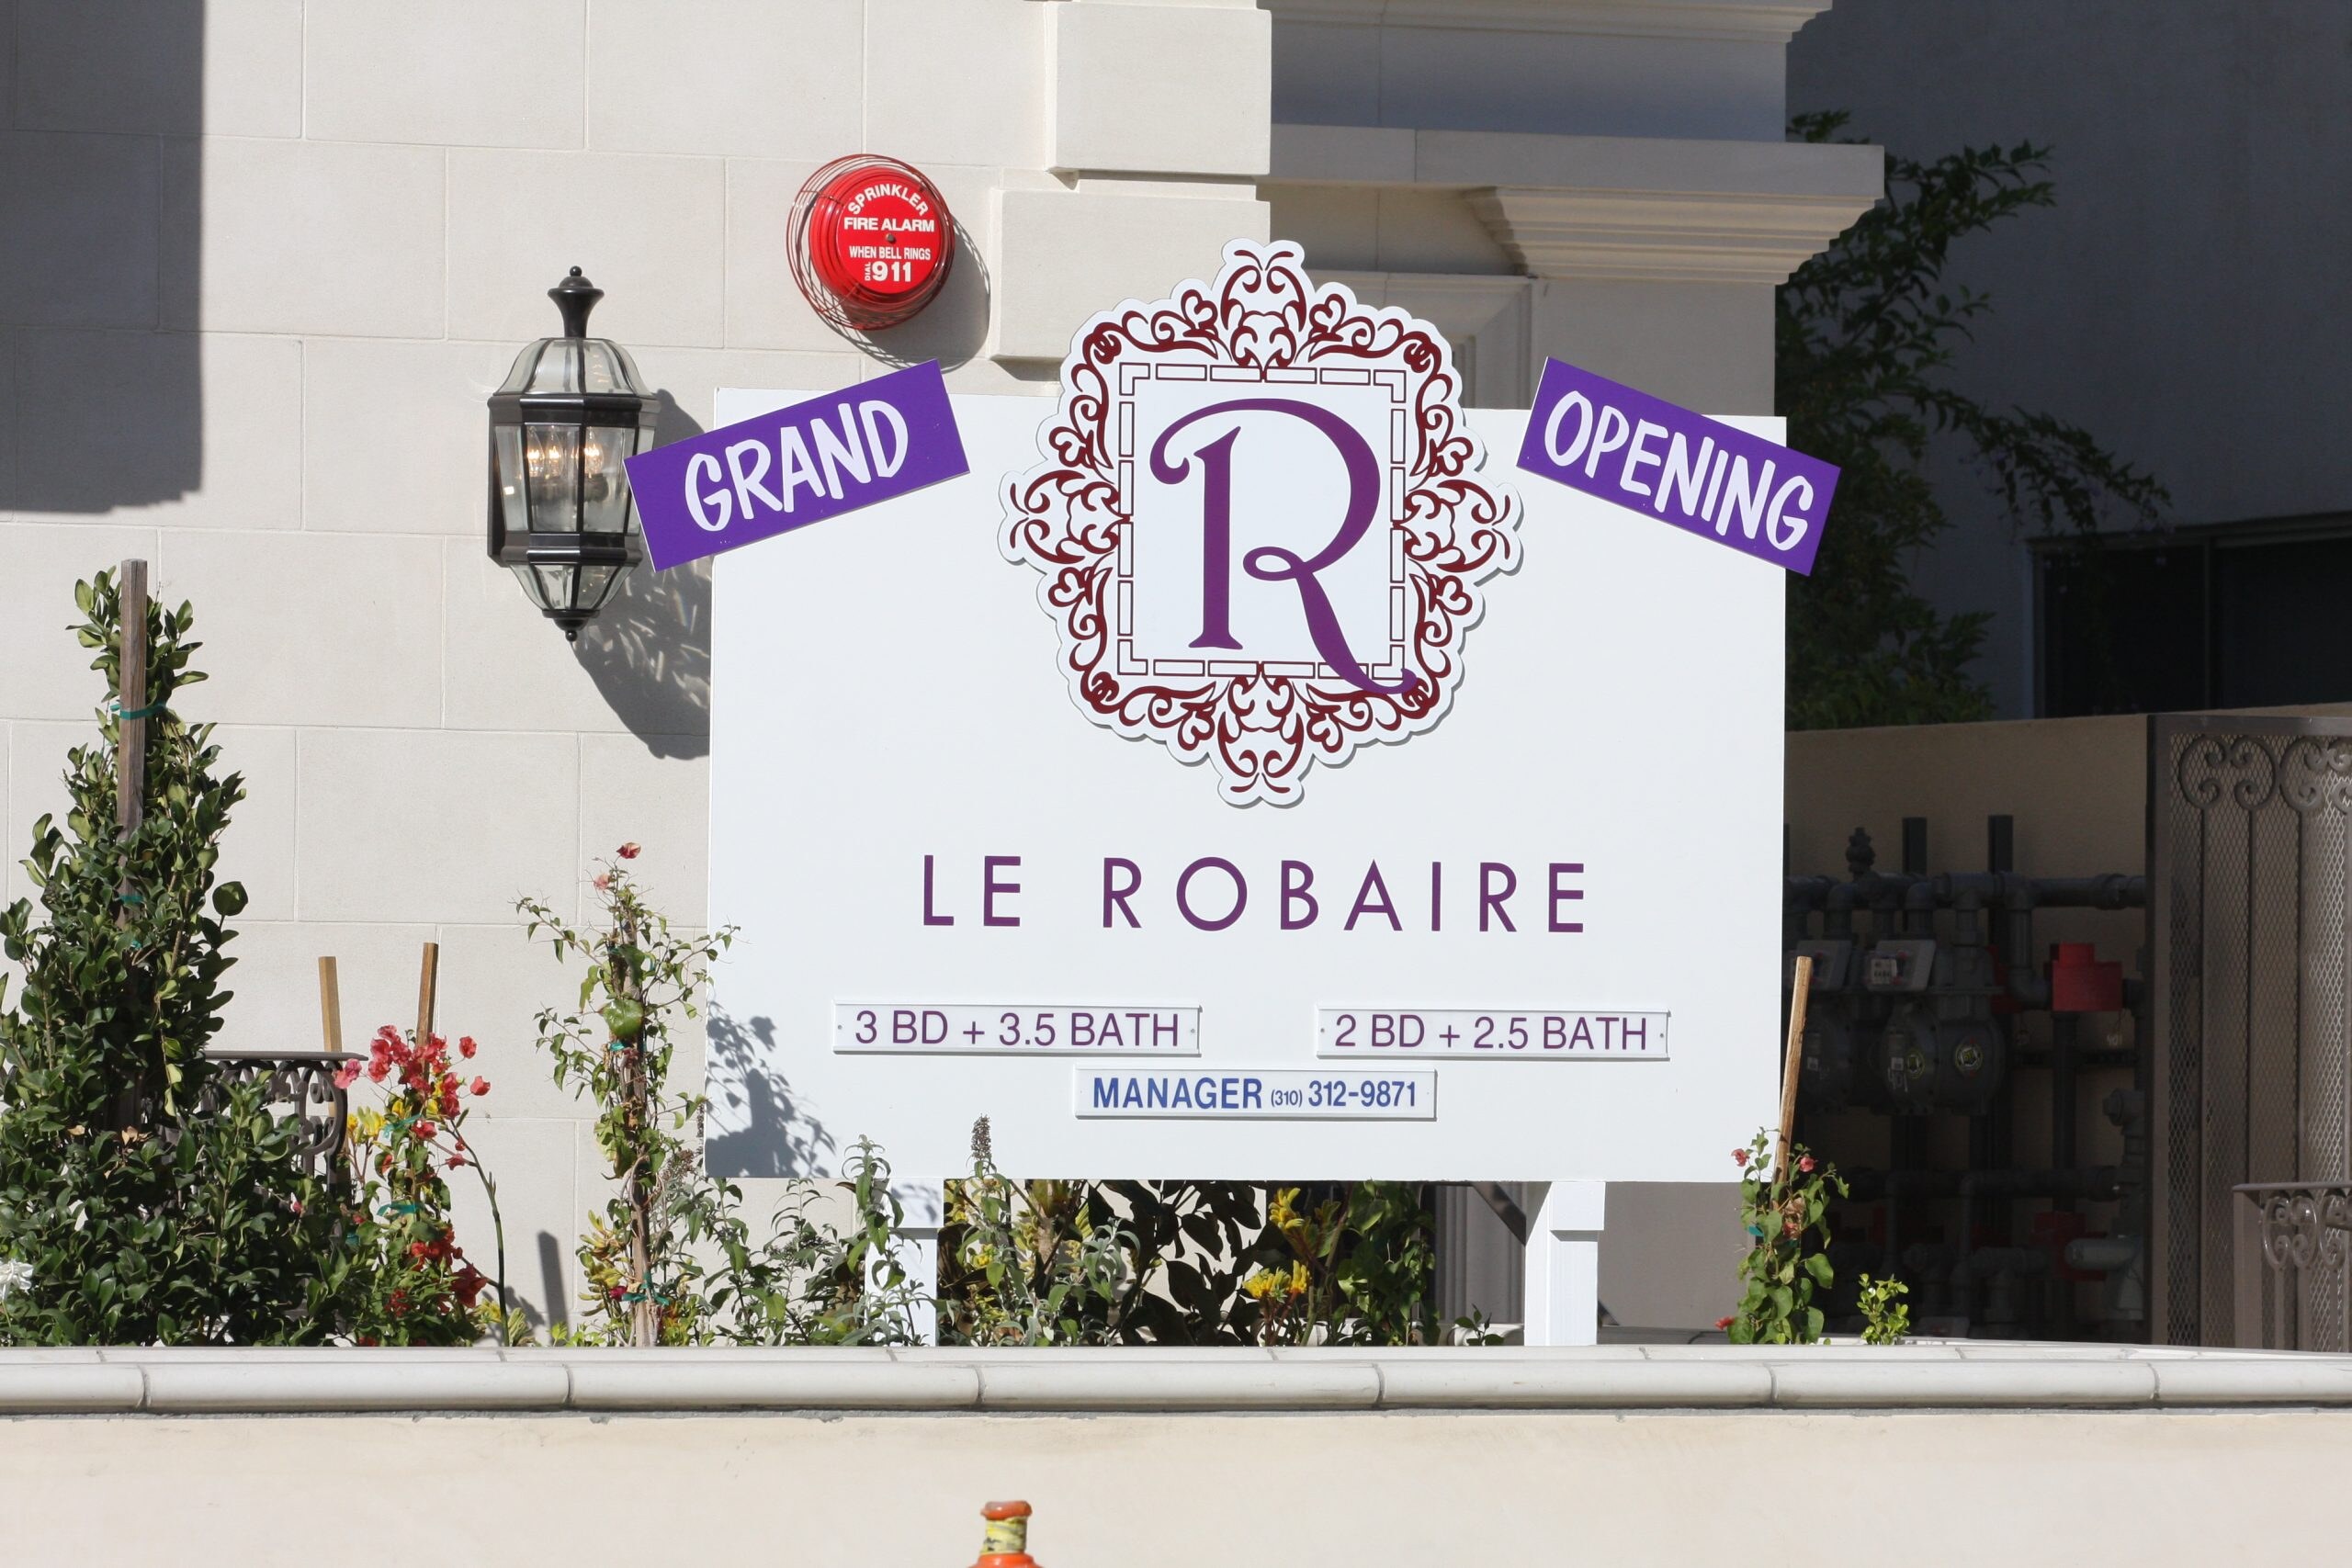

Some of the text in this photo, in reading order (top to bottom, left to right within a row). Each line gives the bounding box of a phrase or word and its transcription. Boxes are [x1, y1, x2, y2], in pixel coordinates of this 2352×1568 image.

[847, 184, 929, 216] SPRINKLER
[843, 217, 935, 232] FIRE ALARM
[849, 246, 931, 261] WHEN BELL RINGS
[872, 261, 911, 282] 911
[684, 400, 909, 532] GRAND
[1544, 390, 1815, 551] OPENING
[1149, 398, 1418, 694] R
[923, 855, 1584, 932] LE ROBAIRE
[855, 1010, 877, 1044] 3
[892, 1010, 948, 1044] BD
[999, 1012, 1056, 1047] 3.5
[1070, 1012, 1179, 1047] BATH
[1335, 1013, 1357, 1047] 2
[1371, 1014, 1425, 1048] BD
[1474, 1016, 1529, 1049] 2.5
[1543, 1017, 1647, 1051] BATH
[1093, 1077, 1416, 1109] MANAGER (310) 312-9871
